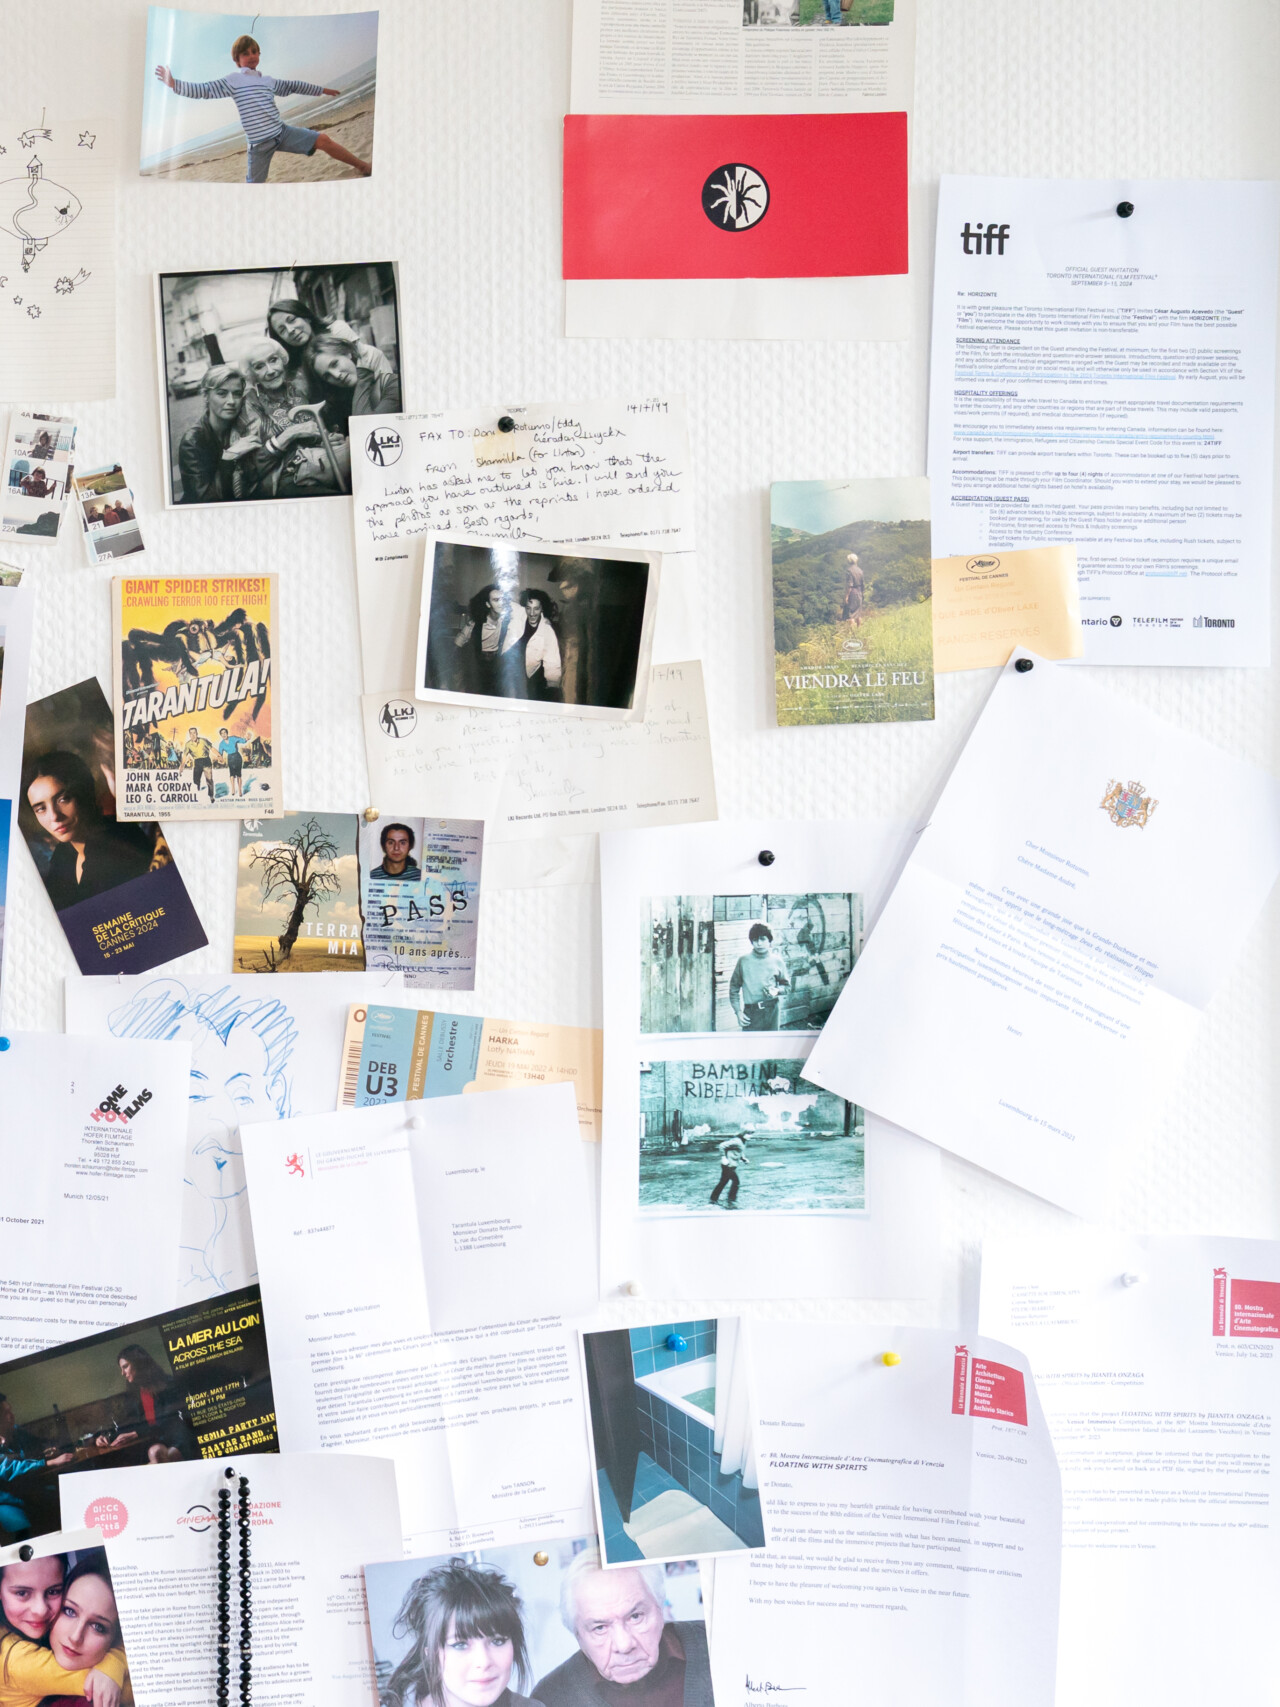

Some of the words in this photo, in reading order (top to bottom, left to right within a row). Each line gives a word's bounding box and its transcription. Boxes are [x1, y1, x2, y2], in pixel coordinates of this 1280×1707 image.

[961, 223, 1010, 255] tiff
[420, 432, 442, 441] FAX
[8, 486, 21, 495] 16A
[2, 525, 16, 533] 22A
[92, 522, 101, 530] 21
[98, 552, 113, 562] 27A
[126, 581, 160, 594] GIANT
[166, 580, 207, 593] SPIDER
[212, 578, 265, 593] STRIKES!
[172, 595, 202, 607] TERROR
[204, 595, 218, 606] 100
[221, 595, 240, 606] FEET
[242, 594, 267, 605] HIGH!
[1081, 618, 1108, 626] ntario
[1204, 617, 1235, 628] TORONTO
[783, 673, 863, 691] VIENDRA
[866, 672, 887, 687] LE
[891, 670, 926, 686] FEU
[123, 658, 270, 730] TARANTULA!
[126, 772, 150, 782] JOHN
[155, 772, 179, 781] AGAR
[126, 783, 153, 793] MARA
[158, 782, 192, 792] CORDAY
[126, 794, 143, 803] LEO
[146, 794, 156, 803] G.
[160, 793, 198, 803] CARROLL
[380, 889, 469, 927] PASS
[92, 912, 133, 934] SEMAINE
[96, 932, 109, 943] DE
[110, 927, 122, 937] LA
[123, 907, 166, 931] CRITIQUE
[99, 930, 135, 950] CANNES
[136, 920, 158, 935] 2024
[306, 922, 358, 938] TERRA
[123, 942, 135, 950] MAI
[328, 940, 358, 955] MIA
[394, 945, 407, 956] 10
[410, 948, 425, 957] ans
[428, 947, 472, 960] après...
[419, 1015, 428, 1044] CANNES
[444, 1021, 458, 1070] Orchestre
[489, 1036, 519, 1045] HARKA
[417, 1045, 424, 1056] DE
[368, 1061, 397, 1074] DEB
[412, 1056, 423, 1091] FESTIVAL
[692, 1063, 777, 1079] BAMBINI
[366, 1075, 398, 1096] U3
[6, 1216, 29, 1224] October
[169, 1340, 185, 1351] LA
[186, 1329, 213, 1347] MER
[214, 1326, 232, 1337] AU
[232, 1313, 260, 1331] LOIN
[173, 1345, 208, 1365] ACROSS
[208, 1342, 226, 1354] THE
[225, 1335, 243, 1348] SEA
[975, 1370, 1005, 1381] Architettura
[975, 1377, 994, 1386] Cinema
[975, 1384, 991, 1392] Danza
[974, 1391, 993, 1399] Musica
[973, 1404, 996, 1414] Archivio
[996, 1408, 1014, 1417] Storico
